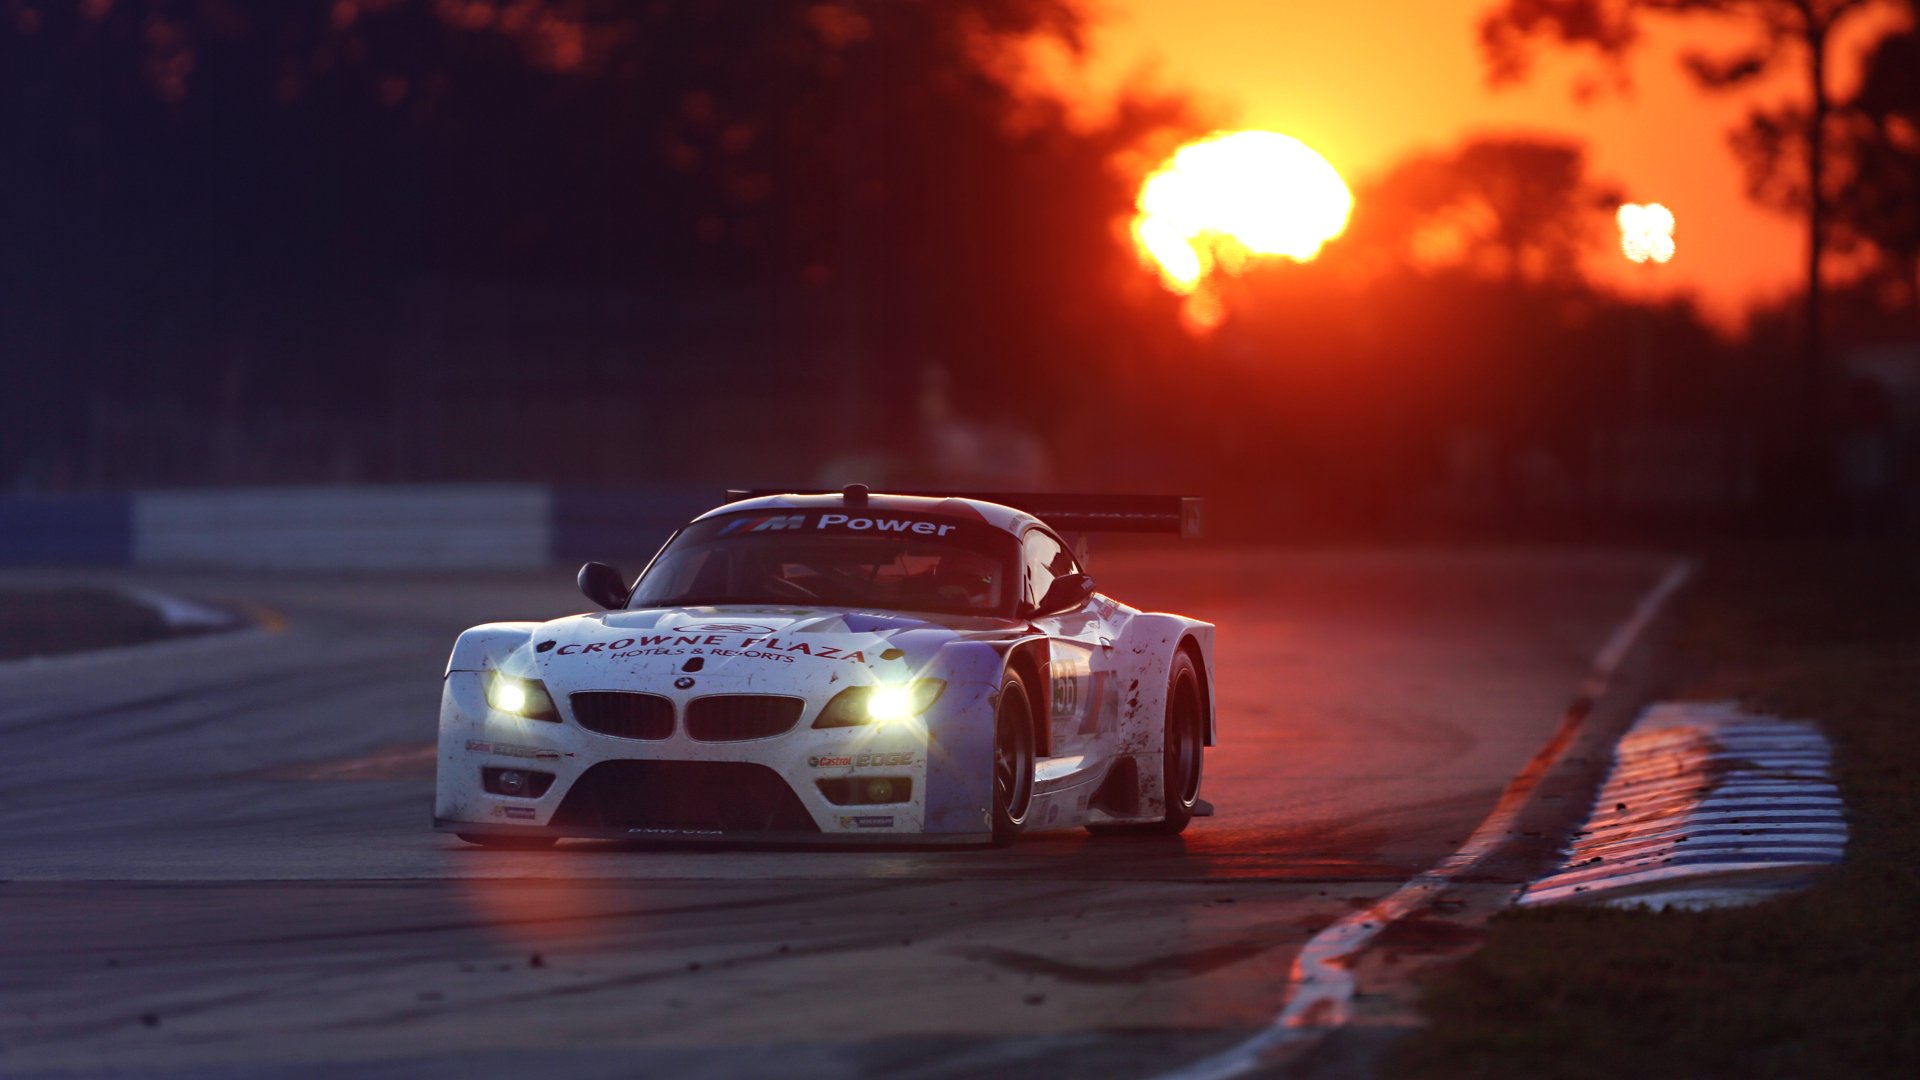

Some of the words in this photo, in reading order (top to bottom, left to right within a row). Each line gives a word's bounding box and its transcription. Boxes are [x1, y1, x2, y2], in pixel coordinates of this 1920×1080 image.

[816, 513, 956, 537] Power
[556, 634, 727, 656] CROWNE
[740, 637, 865, 664] PLAZA
[610, 647, 684, 660] HOTELS
[691, 647, 702, 655] &
[819, 755, 852, 767] Castrol
[856, 751, 914, 767] EDGE
